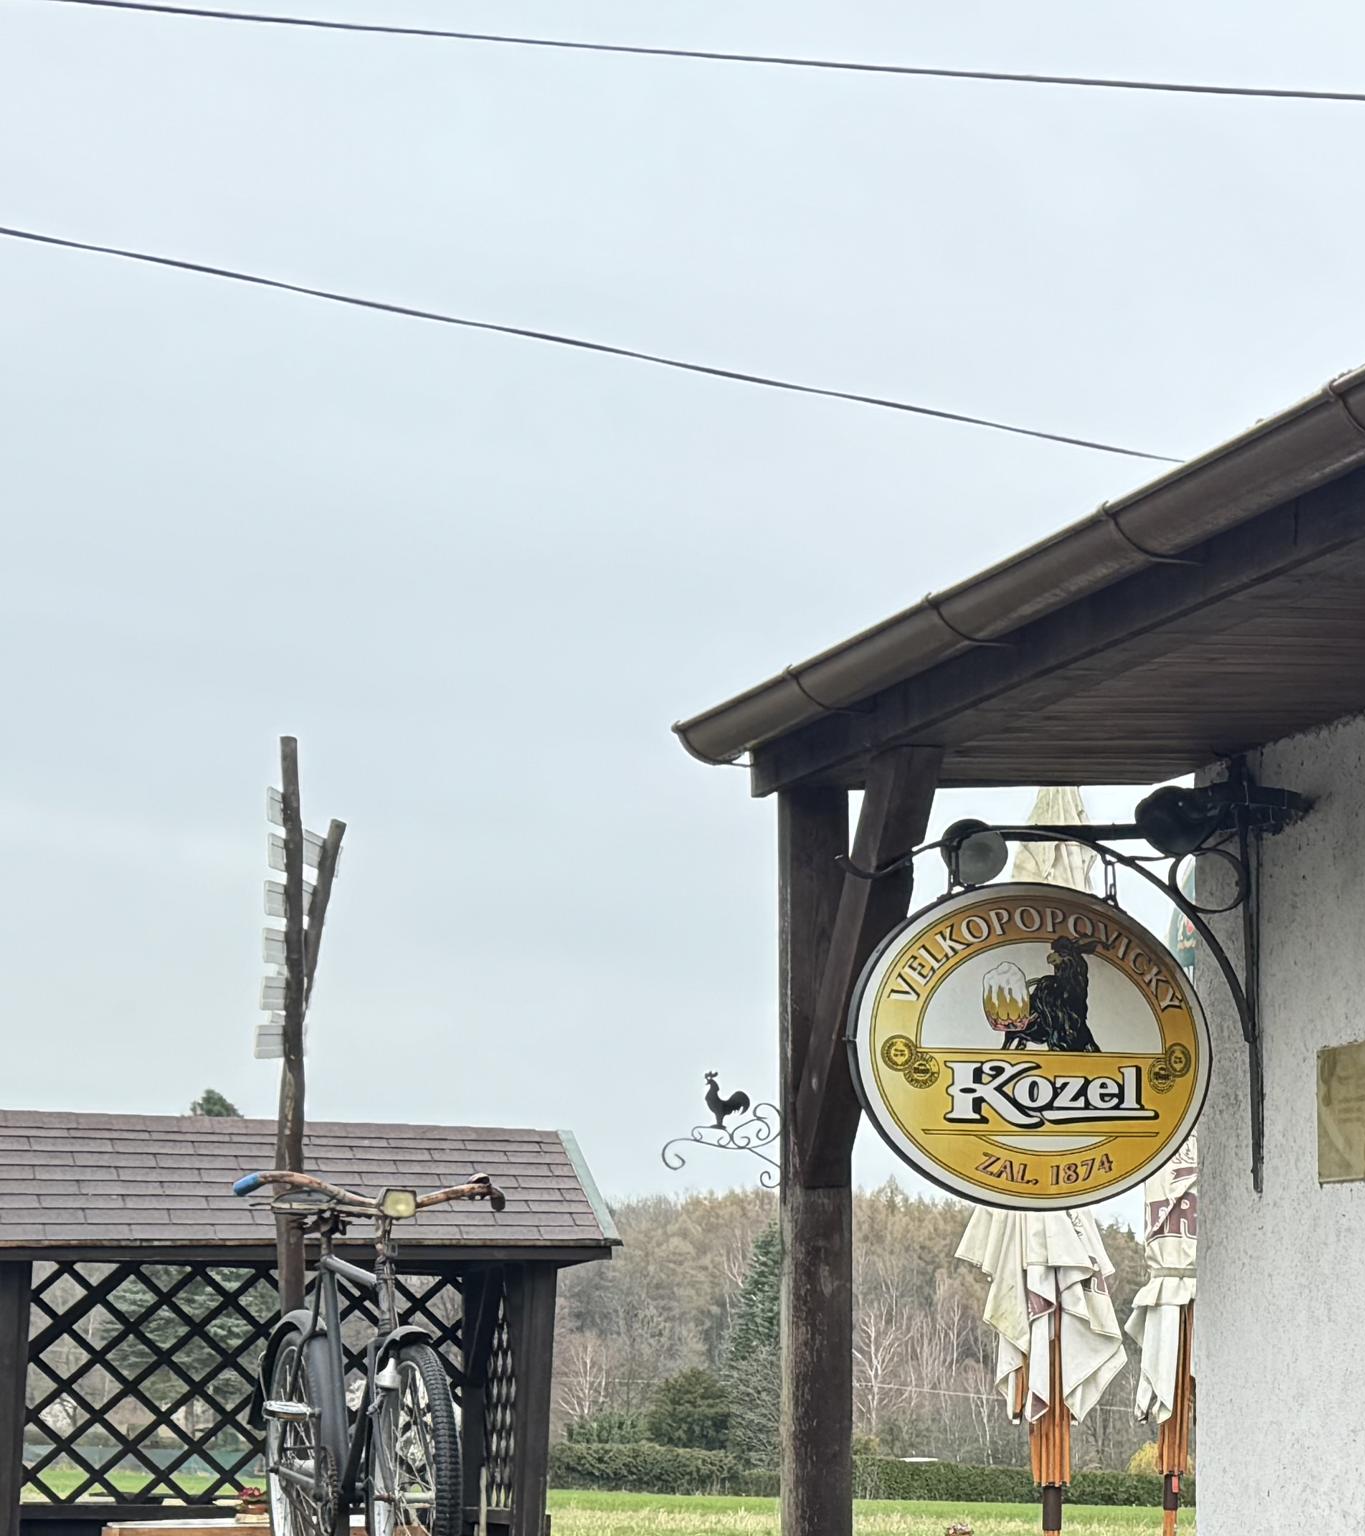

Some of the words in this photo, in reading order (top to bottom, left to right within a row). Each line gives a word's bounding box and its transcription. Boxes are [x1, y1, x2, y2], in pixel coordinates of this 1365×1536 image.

[944, 1058, 1160, 1129] Kozel
[975, 1151, 1039, 1186] ZAL.
[1050, 1153, 1114, 1186] 1874
